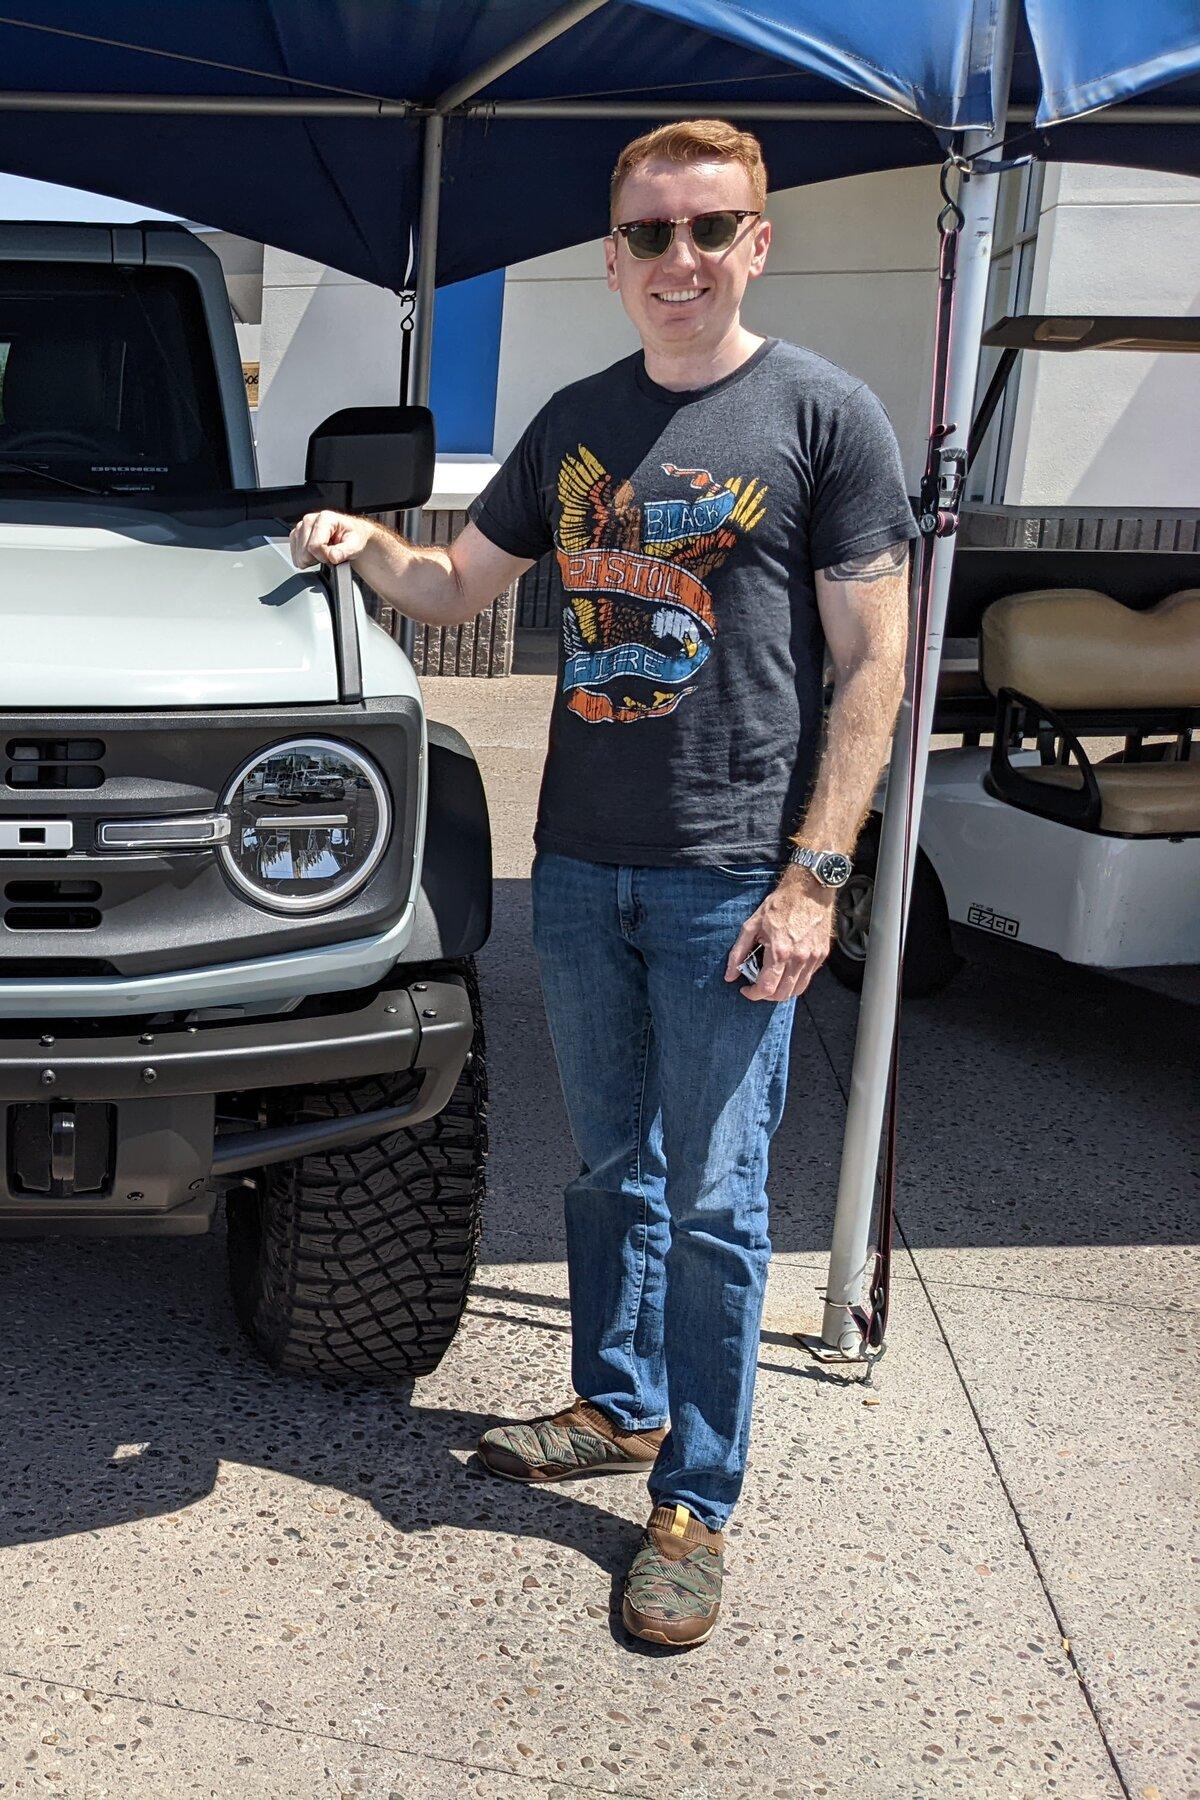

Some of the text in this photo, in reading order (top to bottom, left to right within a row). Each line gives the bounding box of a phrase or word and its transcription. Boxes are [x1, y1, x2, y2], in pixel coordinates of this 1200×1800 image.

[646, 504, 720, 535] BLACK
[569, 556, 681, 599] PISTOL
[574, 650, 664, 679] FIRE
[968, 908, 1018, 937] EZGO
